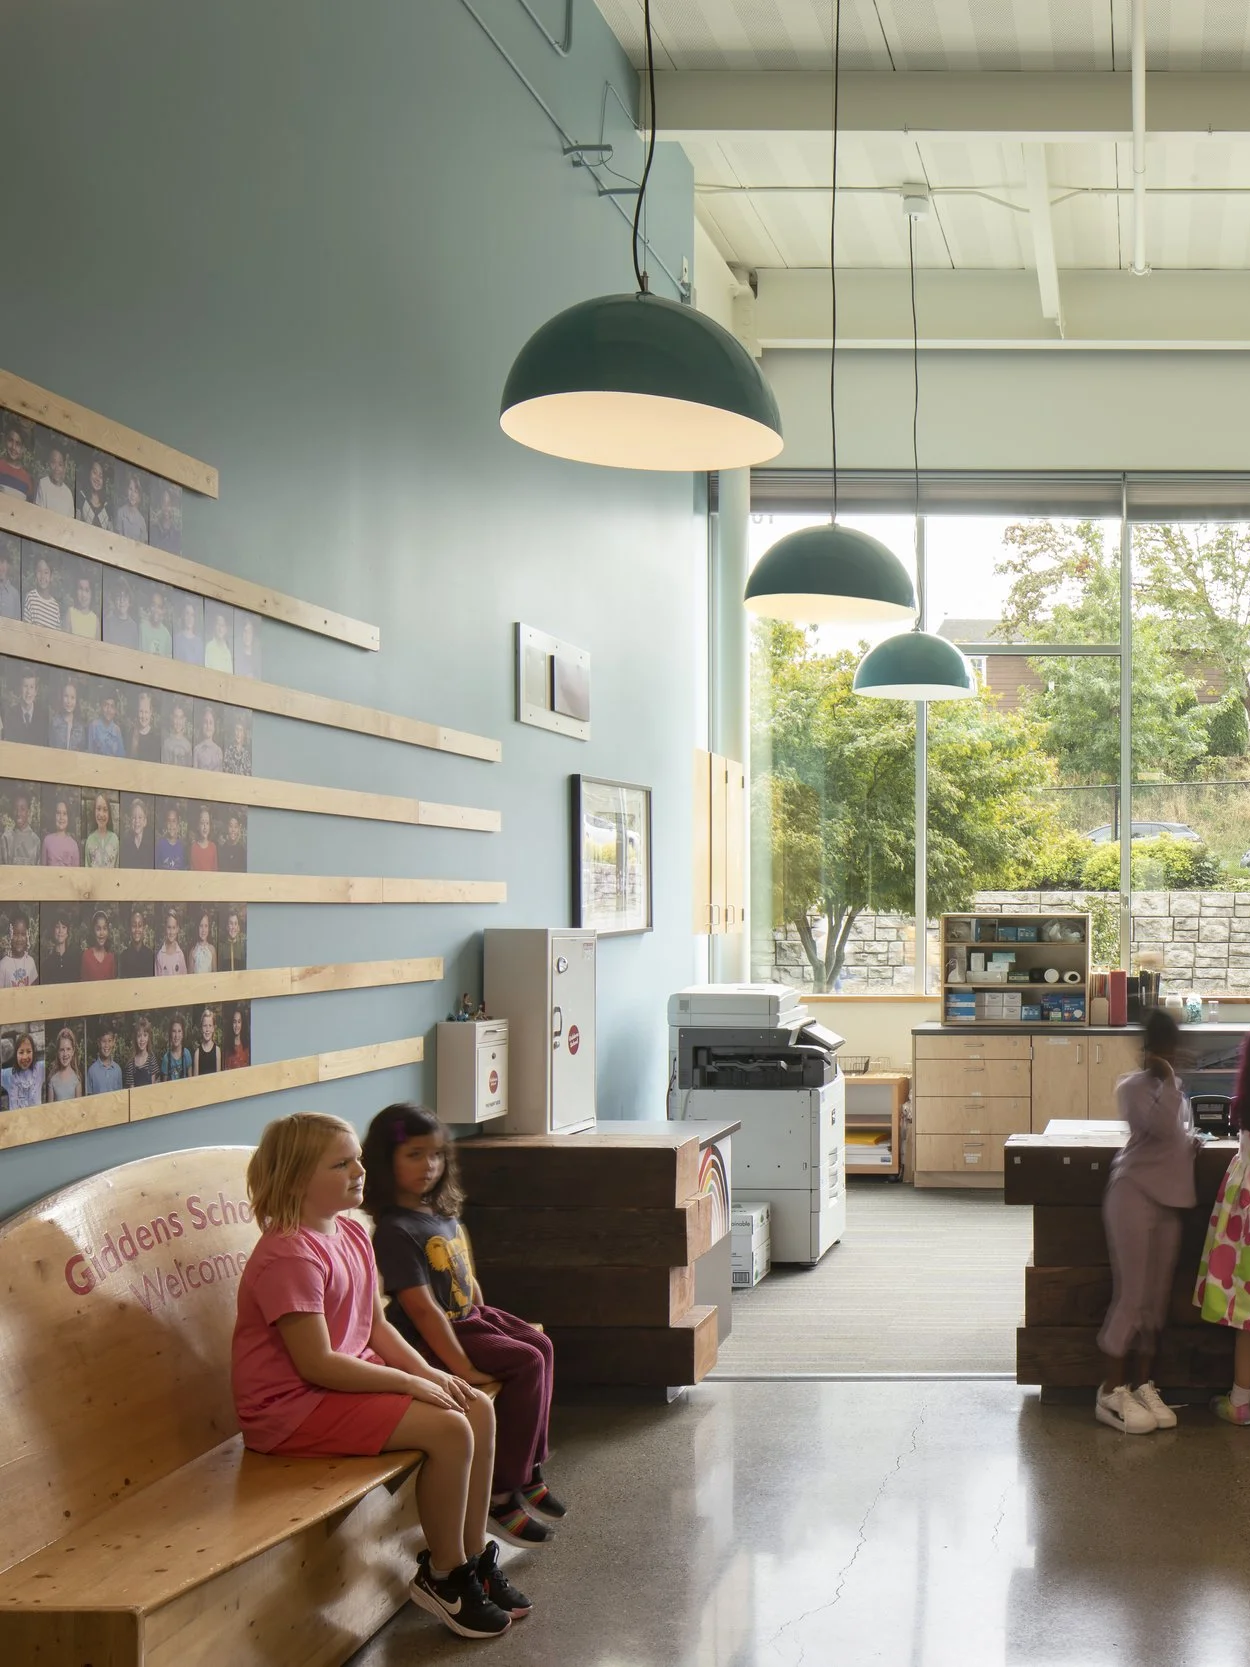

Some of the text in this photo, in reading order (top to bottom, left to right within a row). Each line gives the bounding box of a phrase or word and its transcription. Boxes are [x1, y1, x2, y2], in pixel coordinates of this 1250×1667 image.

[64, 1191, 254, 1296] Giddens Scho
[128, 1251, 248, 1315] Welcome
